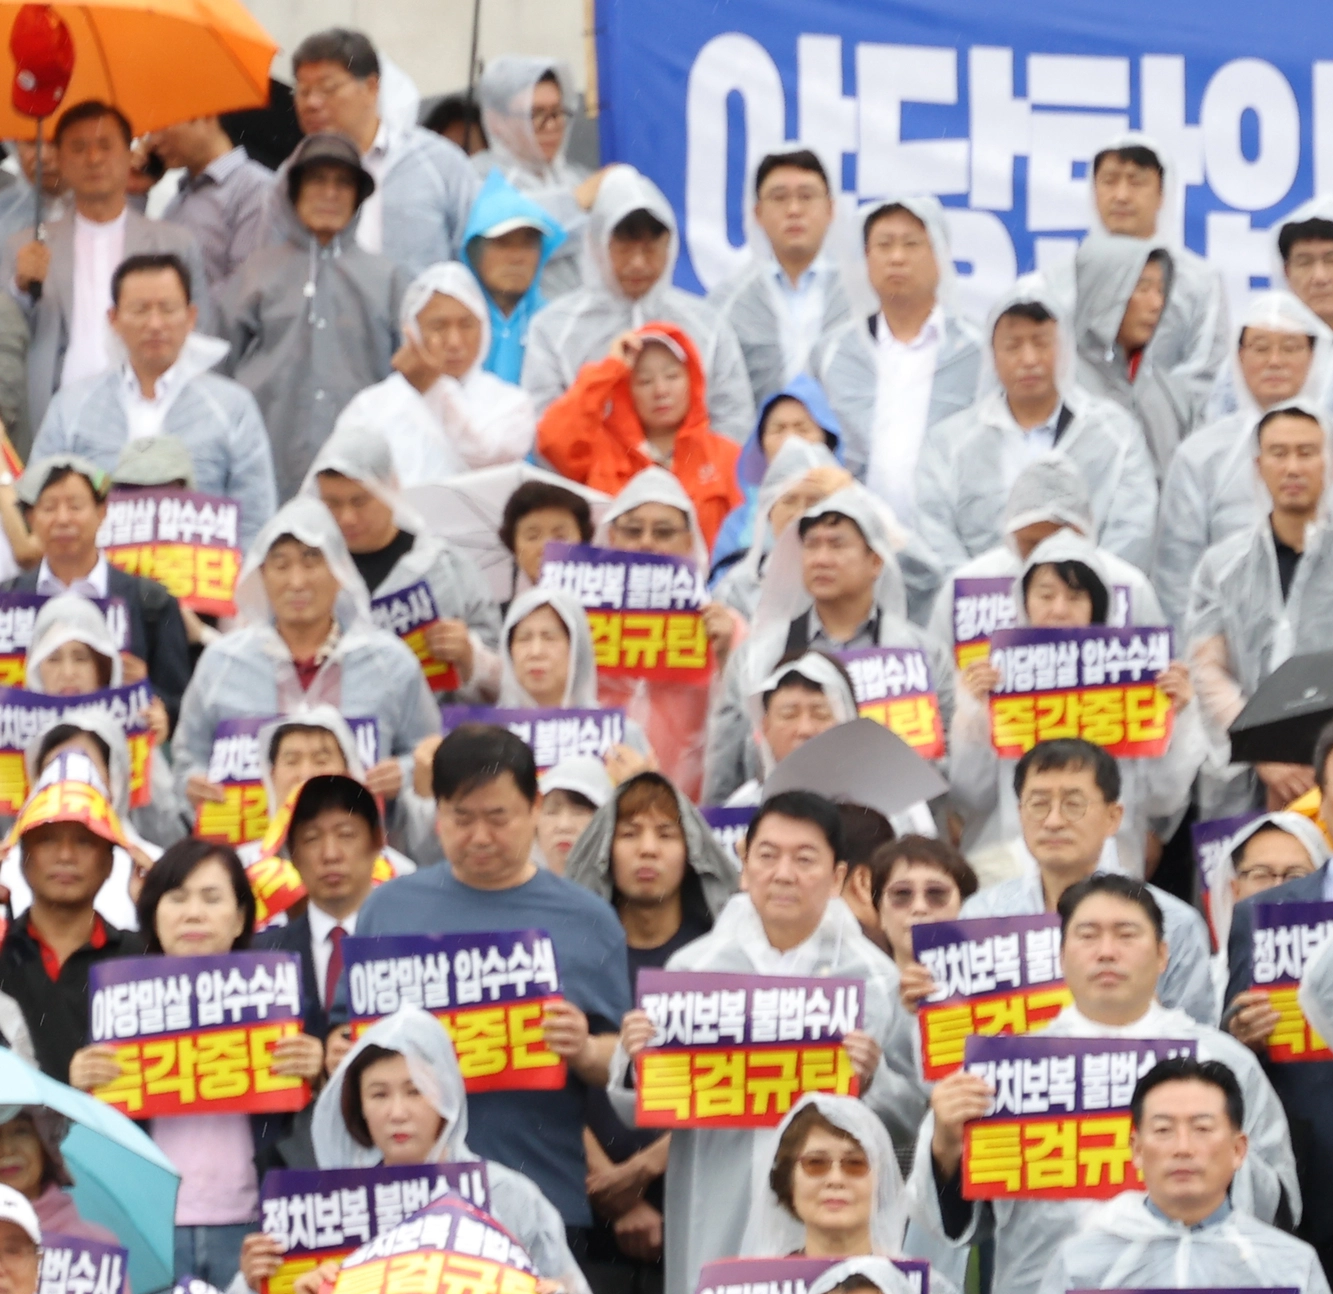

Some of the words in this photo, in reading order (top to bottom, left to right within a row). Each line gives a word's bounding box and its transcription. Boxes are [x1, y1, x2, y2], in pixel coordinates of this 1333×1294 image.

[156, 498, 239, 545] 압수수색
[594, 612, 708, 670] 검규탄
[992, 645, 1078, 692] 야당말살
[1082, 633, 1170, 682] 압수수색
[992, 689, 1170, 747] 즉각중단
[92, 978, 192, 1040] 야당말살
[196, 959, 300, 1019] 압수수색
[350, 954, 449, 1015] 야당말살
[454, 941, 558, 1001] 압수수색
[920, 942, 1018, 1001] 정치보복
[451, 999, 558, 1079] 중단
[642, 988, 745, 1046] 정치보복
[751, 988, 858, 1042] 불법수사
[926, 988, 1073, 1065] 특검규
[641, 1048, 853, 1119] 특검규탄
[969, 1118, 1144, 1191] 특검규
[262, 1188, 371, 1252] 정치보복
